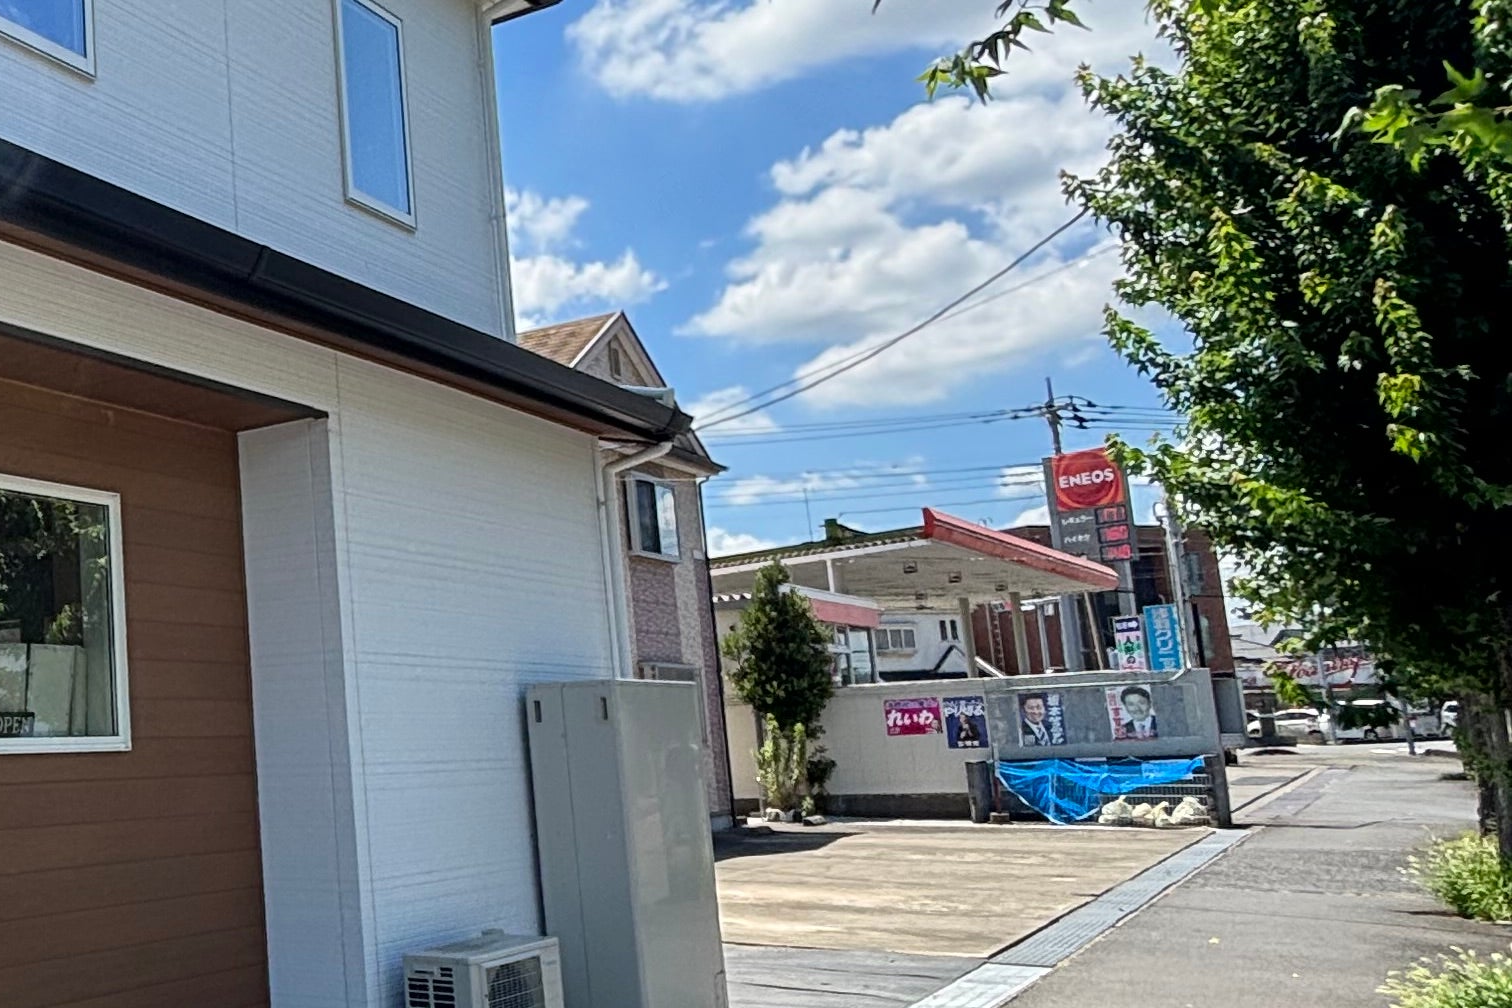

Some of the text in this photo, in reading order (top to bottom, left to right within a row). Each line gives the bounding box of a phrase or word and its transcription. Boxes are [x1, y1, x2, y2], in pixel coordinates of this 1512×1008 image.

[1058, 468, 1115, 489] ENEOS
[887, 709, 934, 728] れいわ
